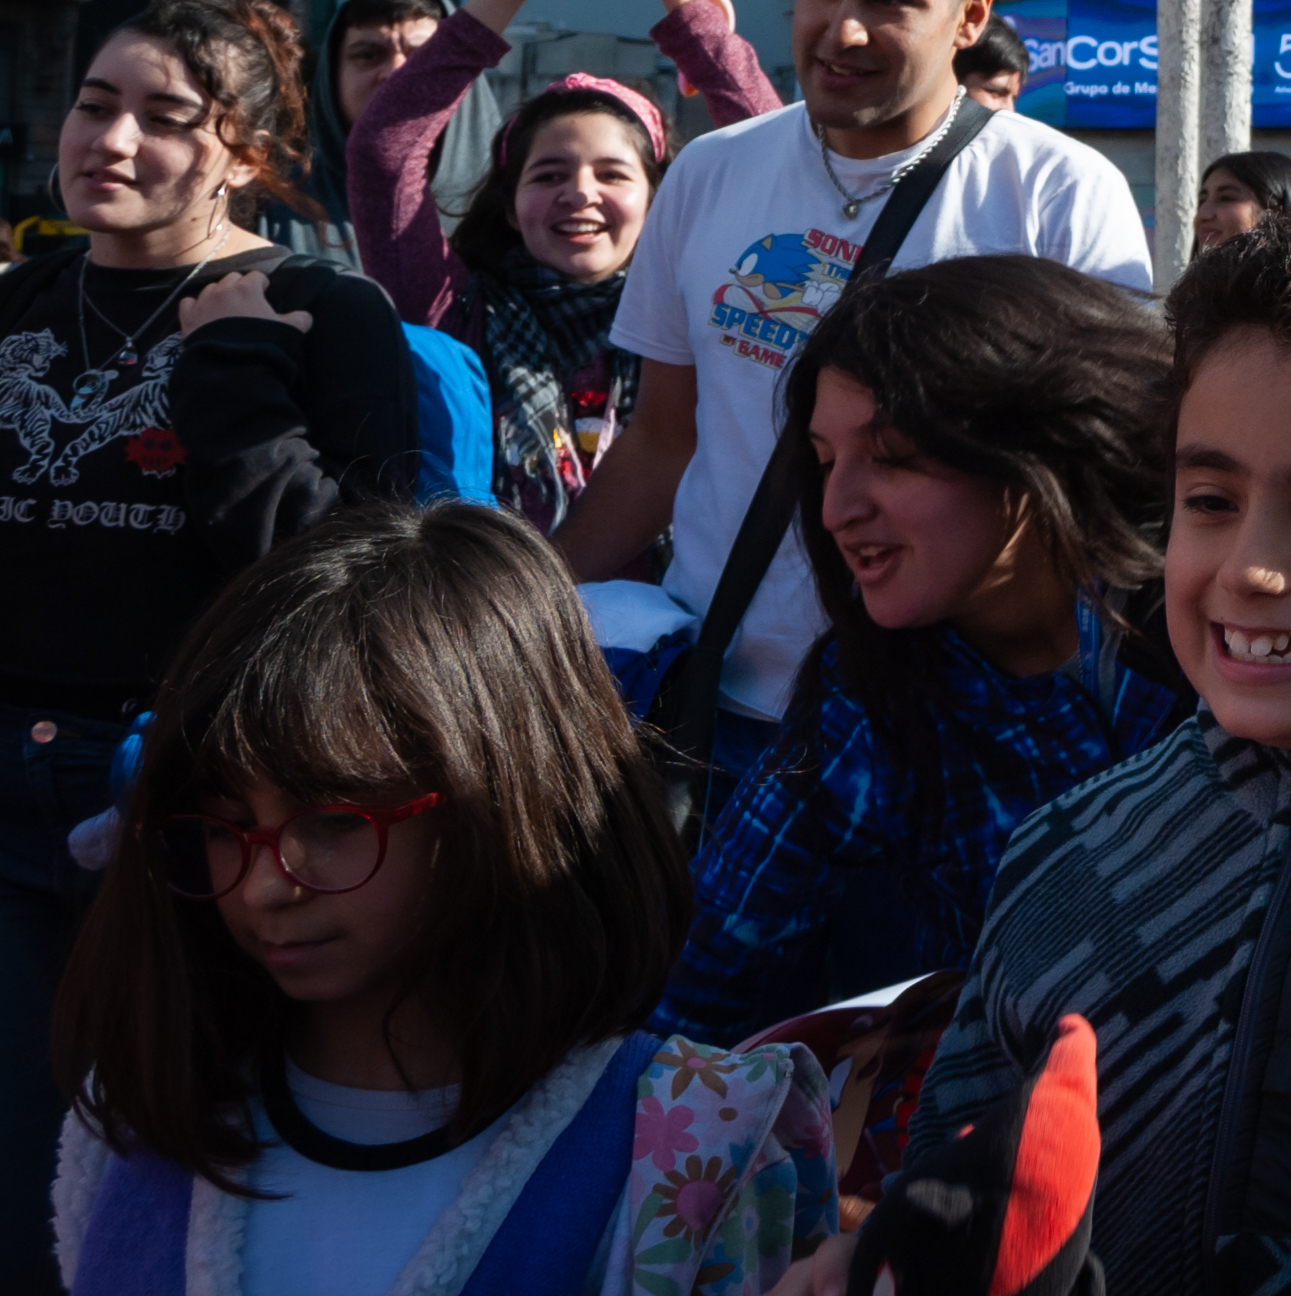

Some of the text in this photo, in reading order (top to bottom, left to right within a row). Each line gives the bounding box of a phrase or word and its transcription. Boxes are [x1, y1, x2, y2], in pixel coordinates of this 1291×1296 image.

[1064, 82, 1109, 97] Grupo
[1112, 81, 1131, 95] de
[734, 340, 786, 370] GAME
[46, 499, 187, 535] YOUTH
